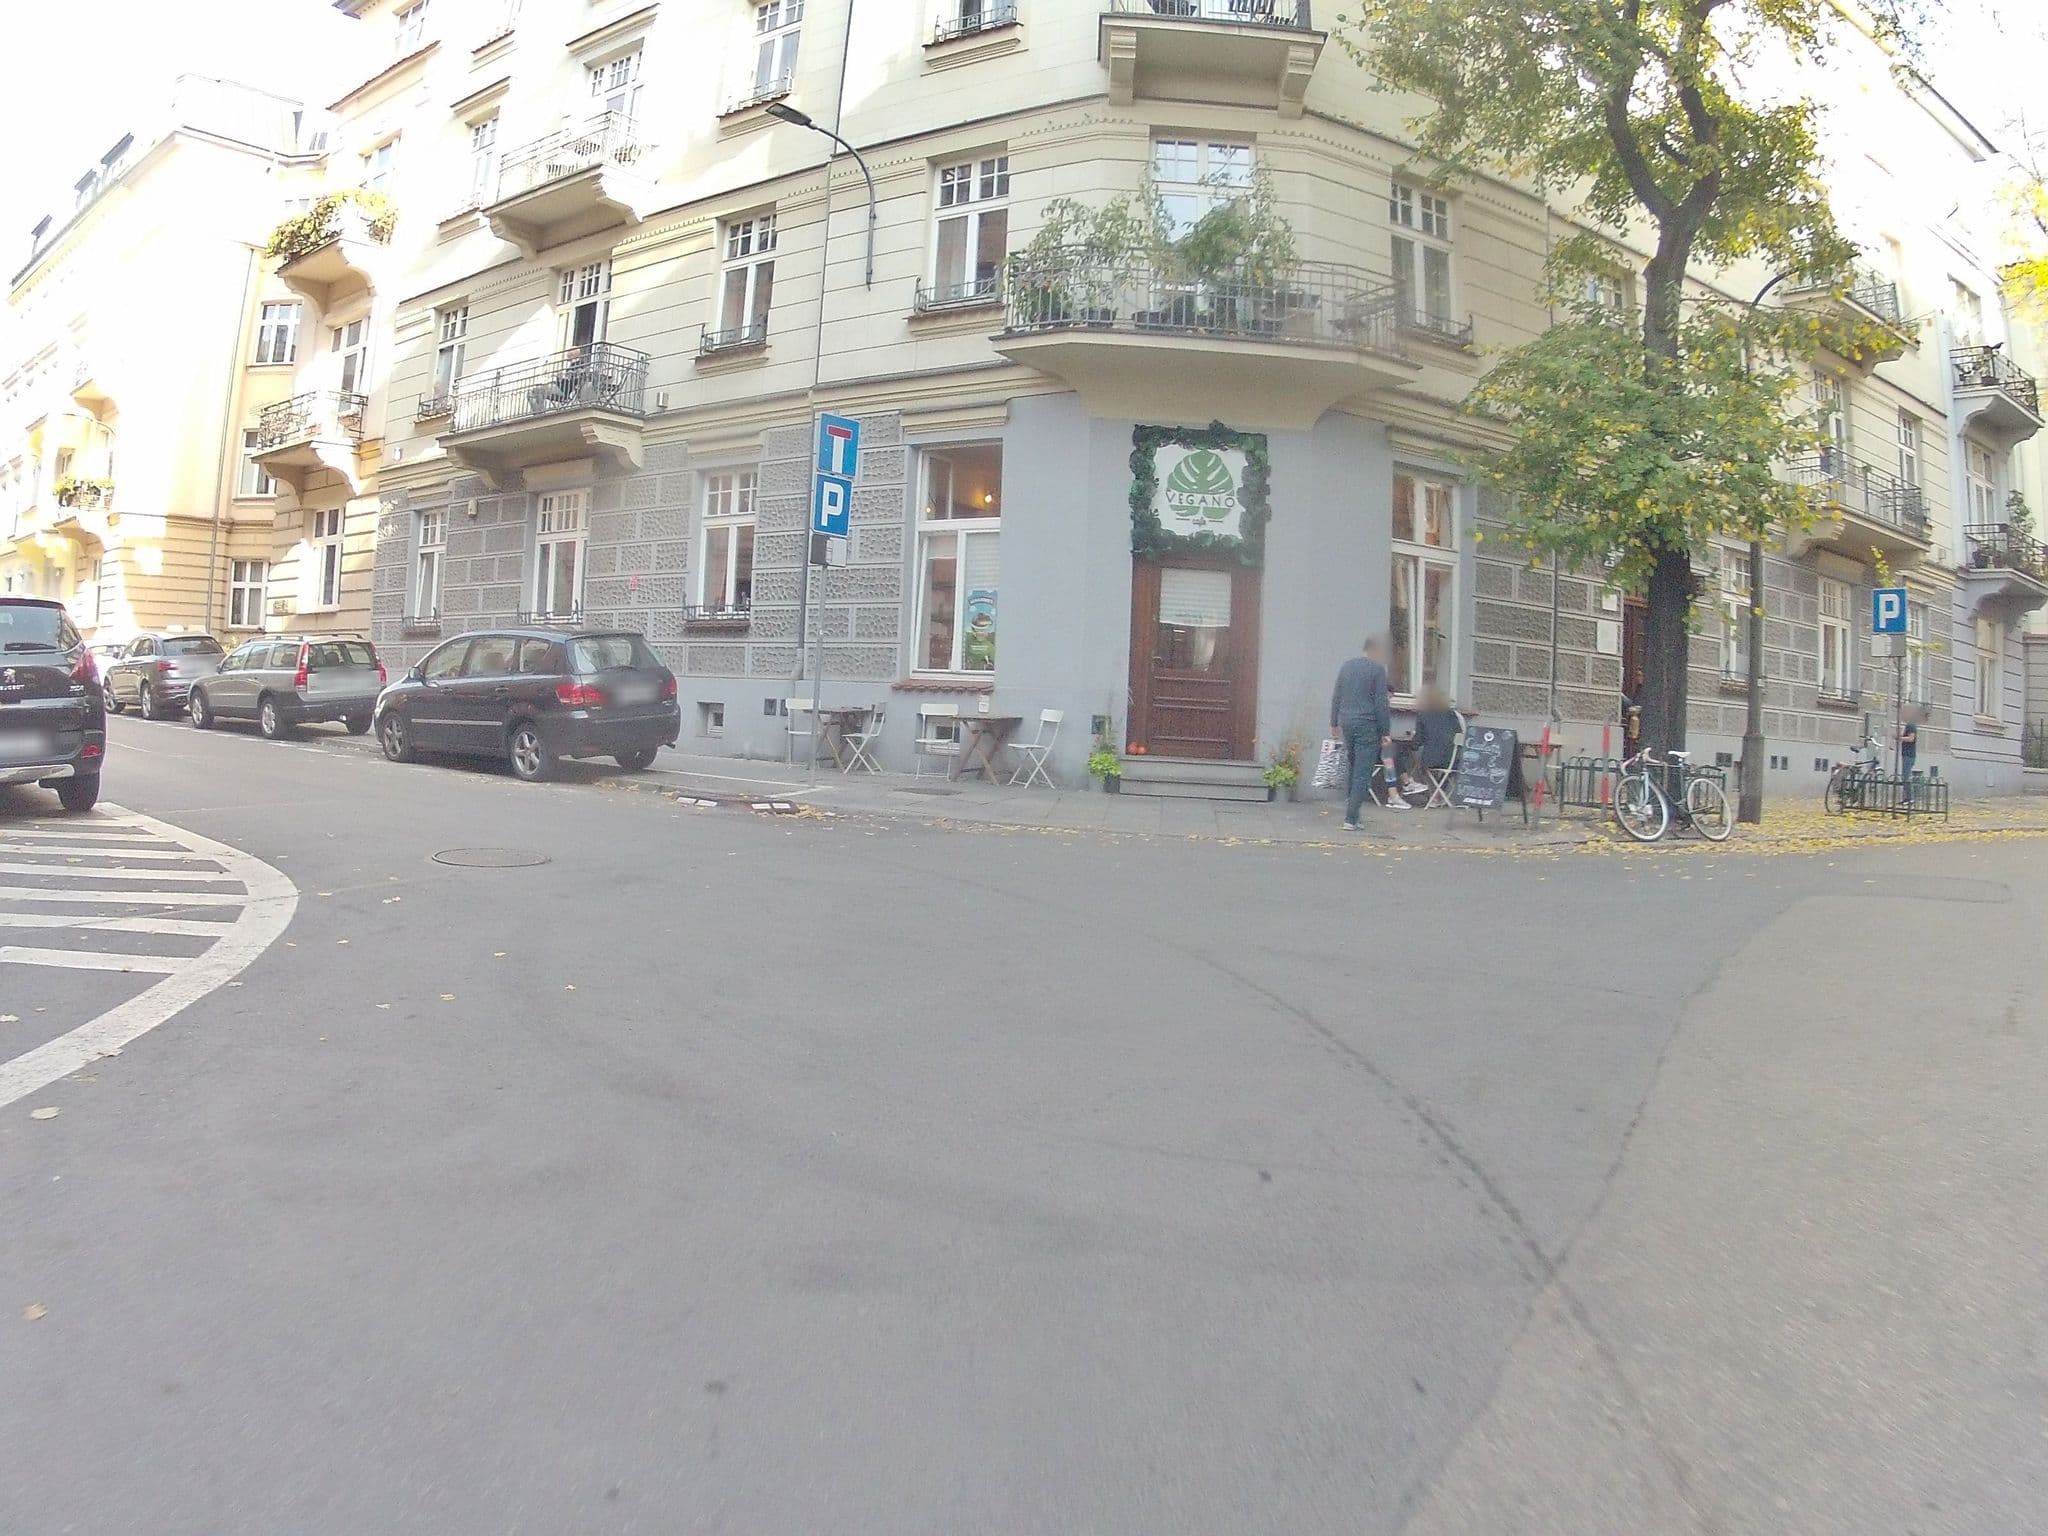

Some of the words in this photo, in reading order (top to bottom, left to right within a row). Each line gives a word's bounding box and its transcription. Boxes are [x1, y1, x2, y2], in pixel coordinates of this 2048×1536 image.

[820, 481, 845, 527] P
[1165, 489, 1236, 508] VEGANO
[1878, 593, 1901, 629] P
